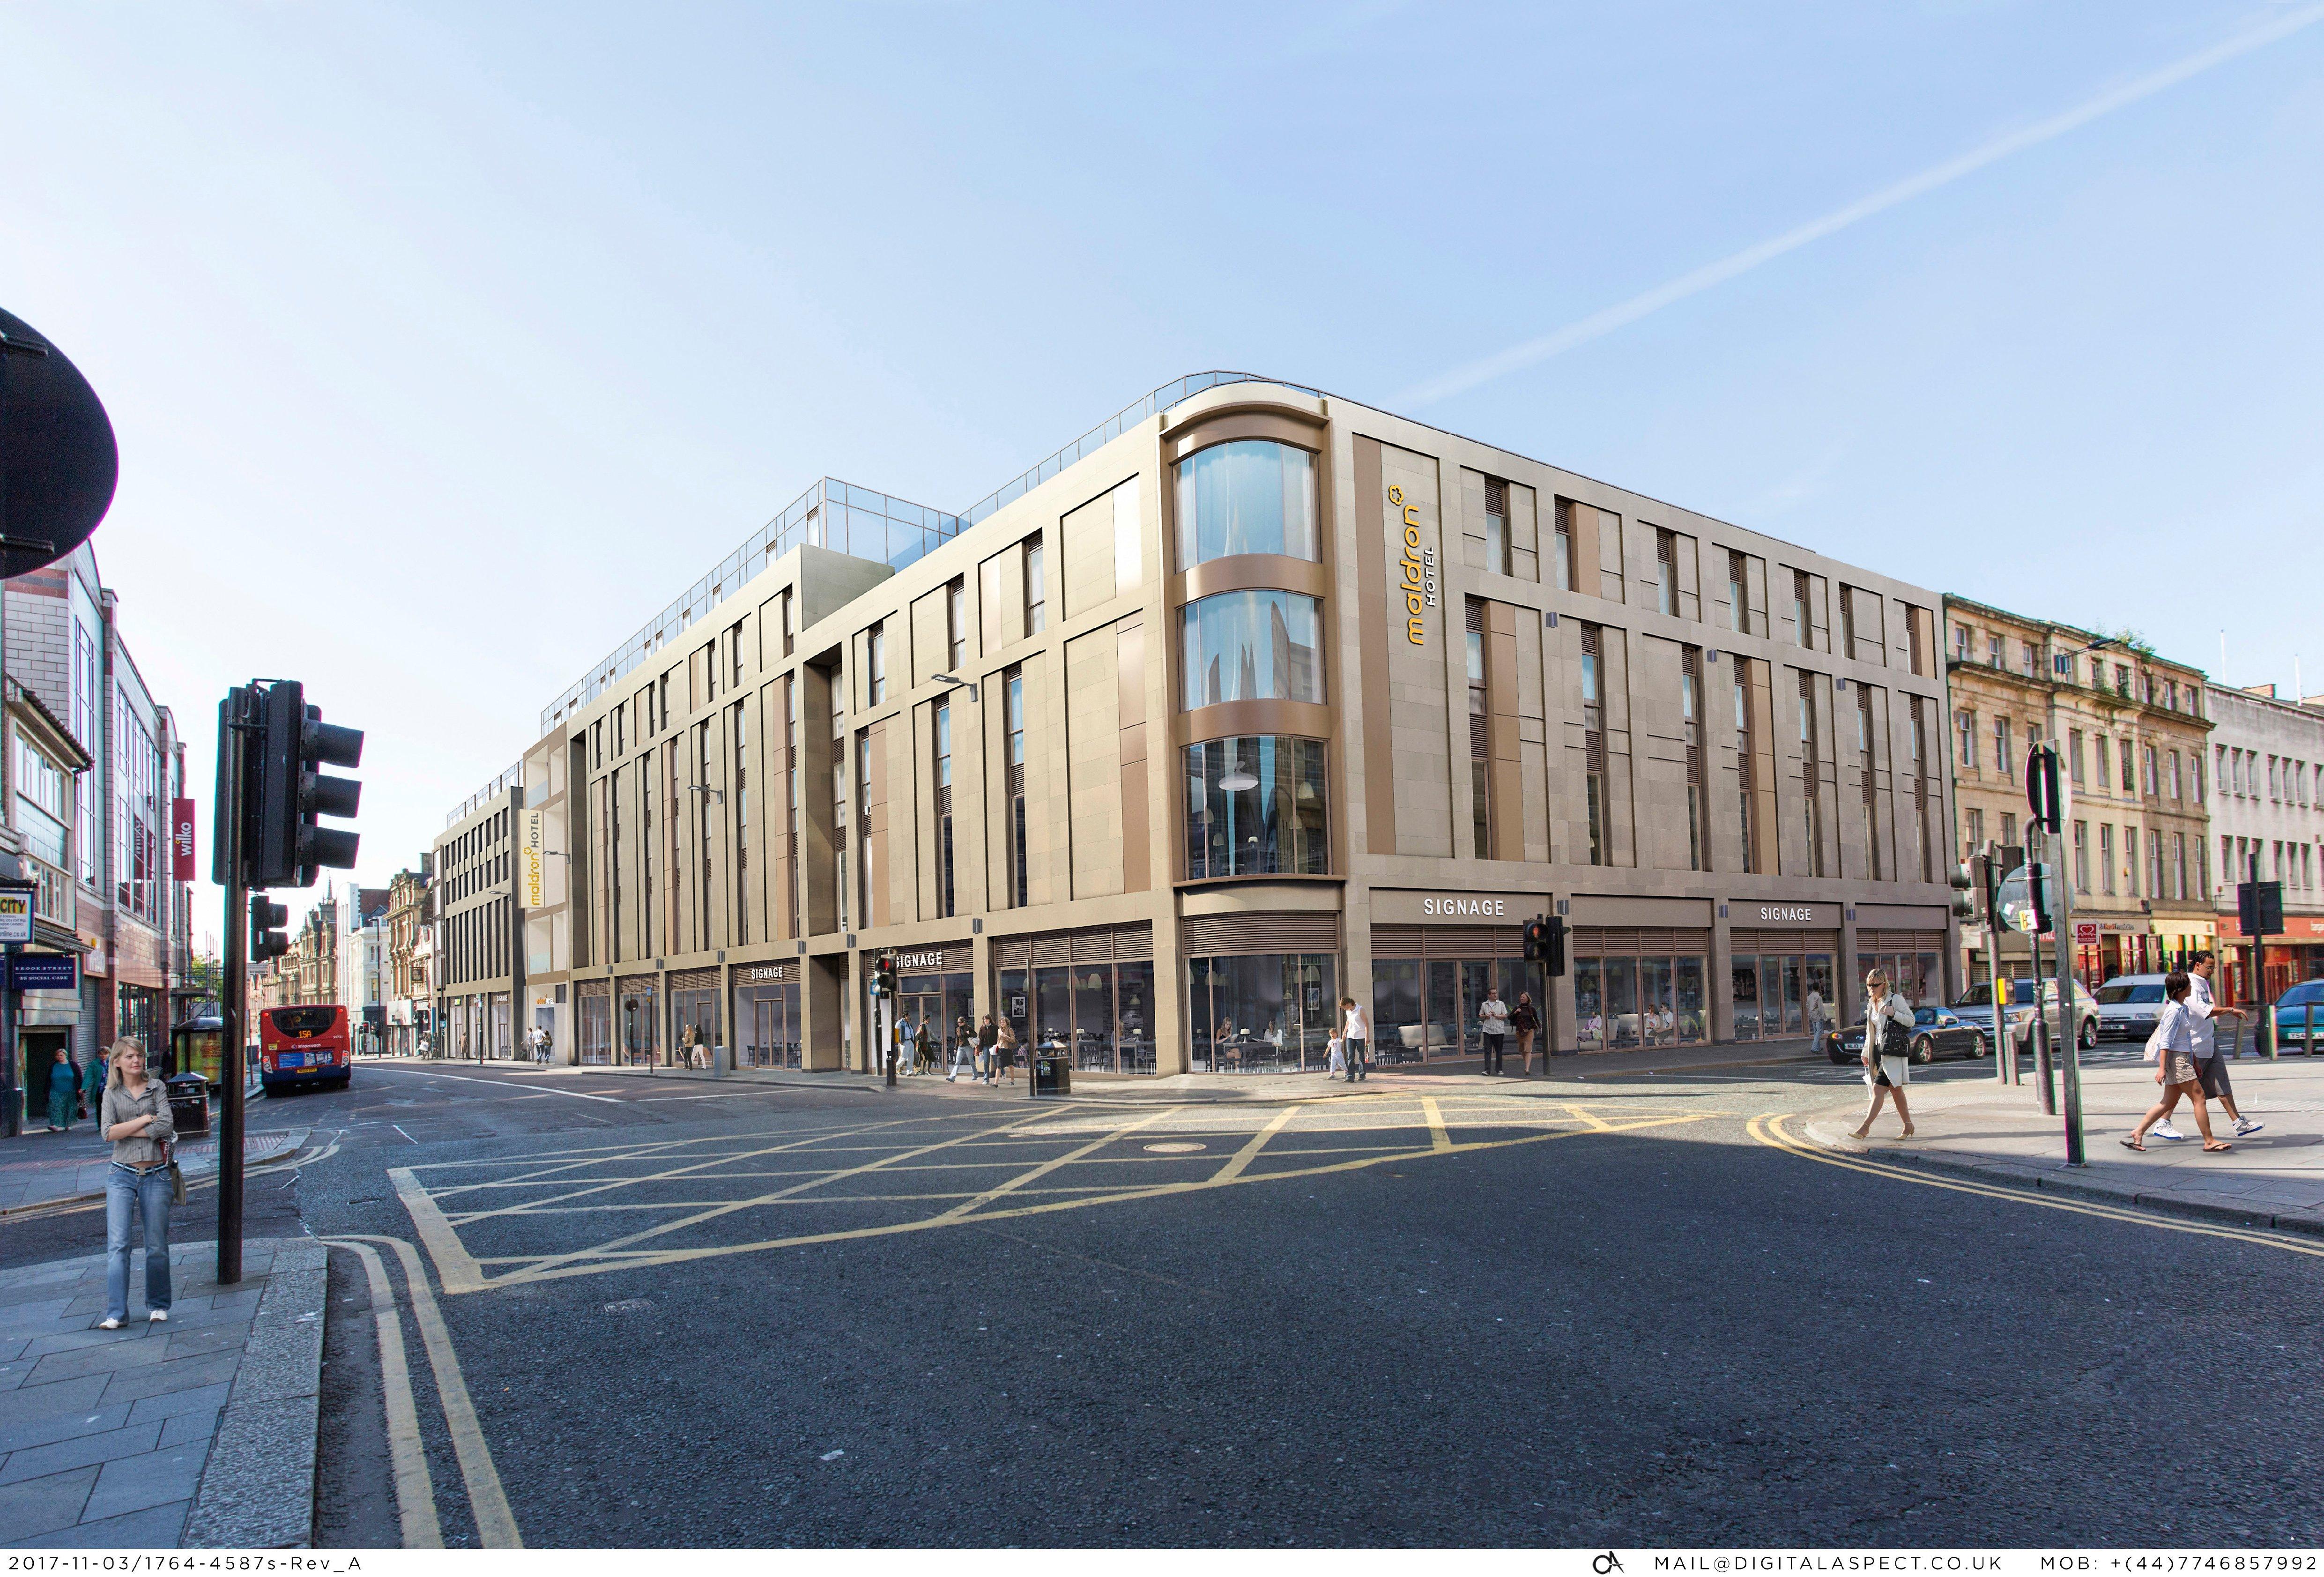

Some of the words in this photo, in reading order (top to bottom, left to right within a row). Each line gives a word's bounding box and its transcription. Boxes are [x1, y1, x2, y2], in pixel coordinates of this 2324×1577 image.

[1400, 504, 1424, 645] maldron
[1424, 547, 1436, 606] HOTEL
[176, 822, 192, 856] wilko
[531, 812, 539, 848] HOTEL
[528, 852, 540, 905] maldron
[0, 899, 26, 913] CITY
[1424, 898, 1504, 916] SIGNAGE
[1760, 907, 1812, 921] SIGNAGE
[751, 967, 783, 980] SIGNAGE
